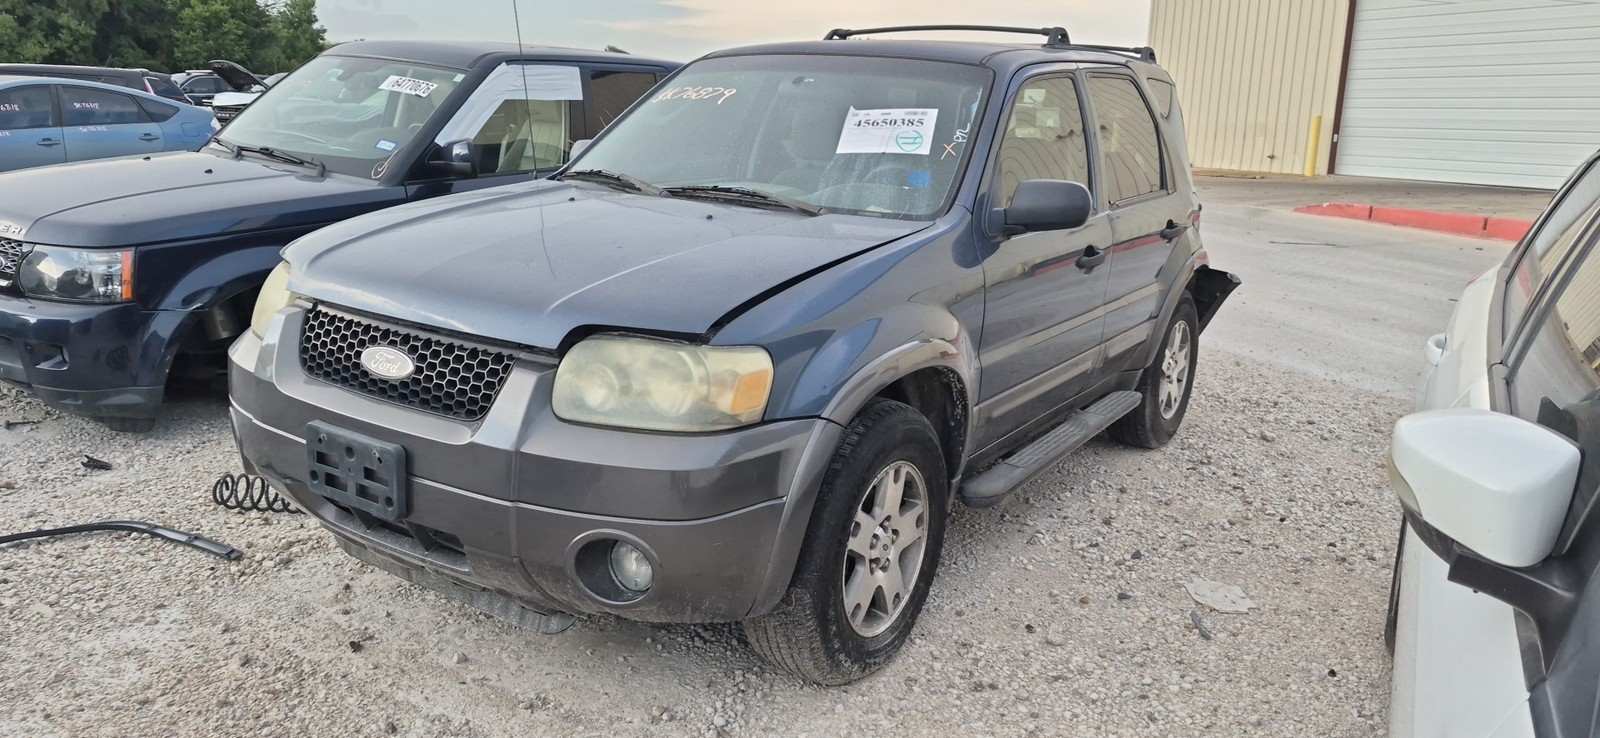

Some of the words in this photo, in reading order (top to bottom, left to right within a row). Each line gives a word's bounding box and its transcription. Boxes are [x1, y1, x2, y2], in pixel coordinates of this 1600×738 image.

[391, 77, 434, 94] 64770676
[854, 118, 924, 128] 45650385
[0, 224, 23, 235] ER
[371, 351, 402, 374] Ford
